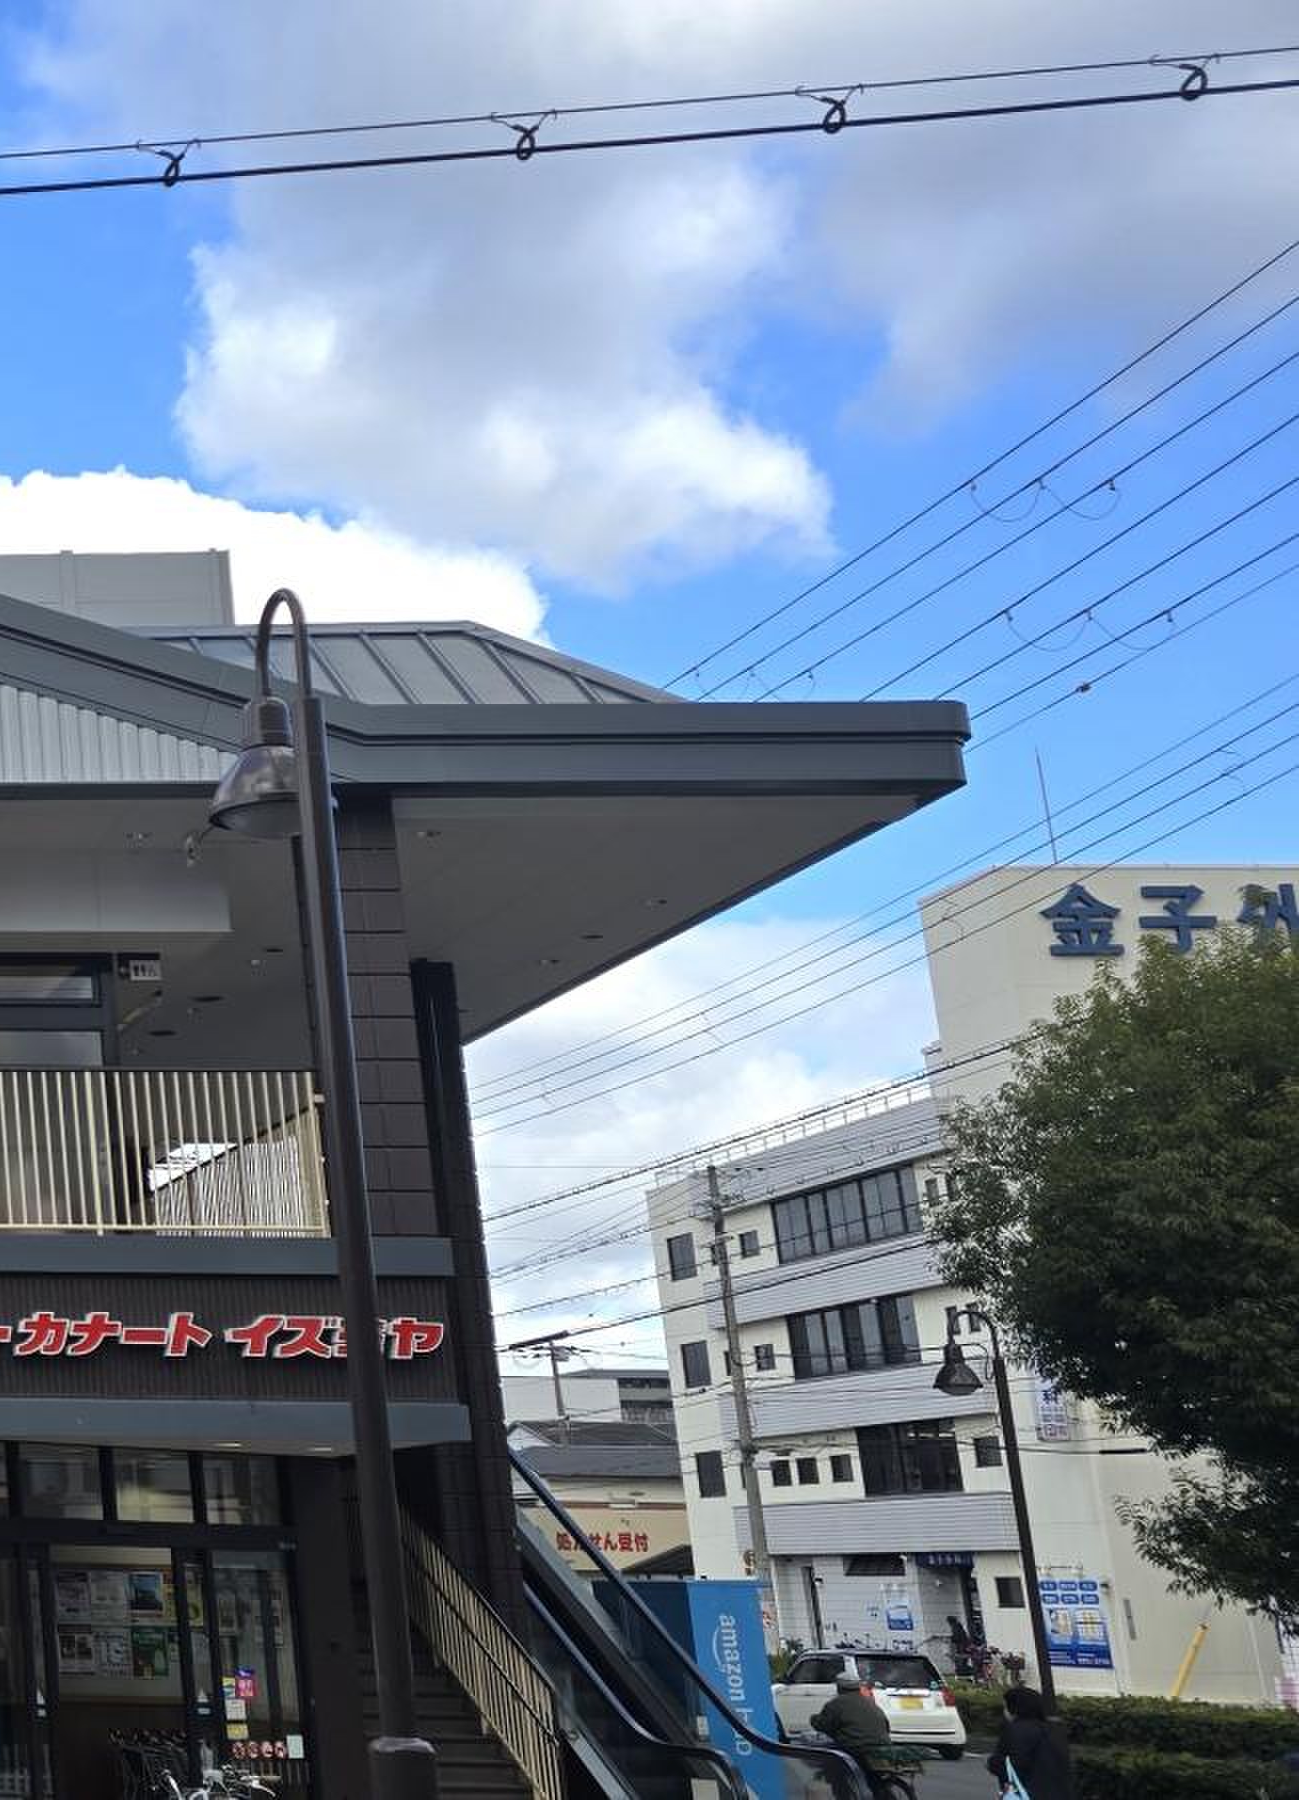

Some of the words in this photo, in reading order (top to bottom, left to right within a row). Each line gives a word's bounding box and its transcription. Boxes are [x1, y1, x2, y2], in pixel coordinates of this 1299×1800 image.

[13, 1310, 212, 1357] カナート
[719, 1614, 747, 1701] amazon
